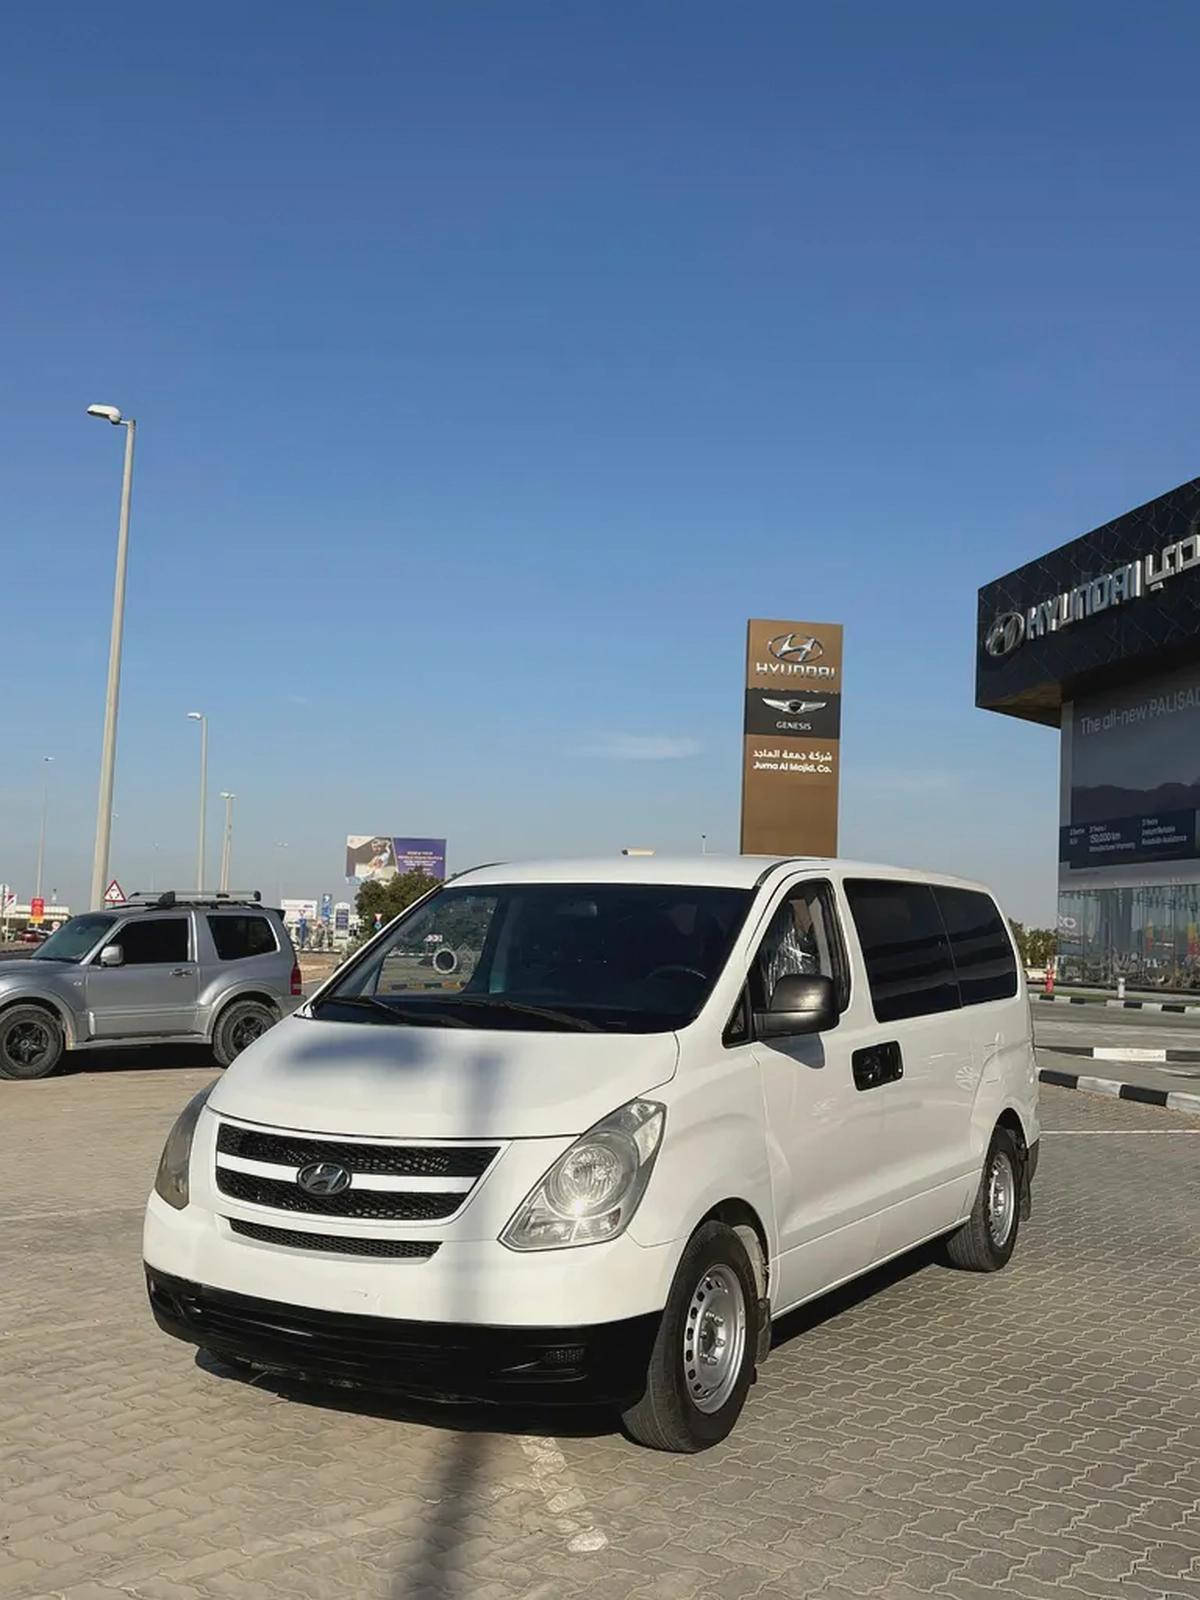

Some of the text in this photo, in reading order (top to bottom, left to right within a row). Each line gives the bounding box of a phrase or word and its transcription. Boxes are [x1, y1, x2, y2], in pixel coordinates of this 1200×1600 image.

[1026, 560, 1142, 640] HYUNDAI
[756, 662, 836, 676] HYUNDAI
[776, 720, 812, 731] GENESIS
[1081, 716, 1101, 735] The
[1103, 705, 1147, 729] all-new
[752, 761, 779, 770] Juma
[779, 762, 789, 771] Al
